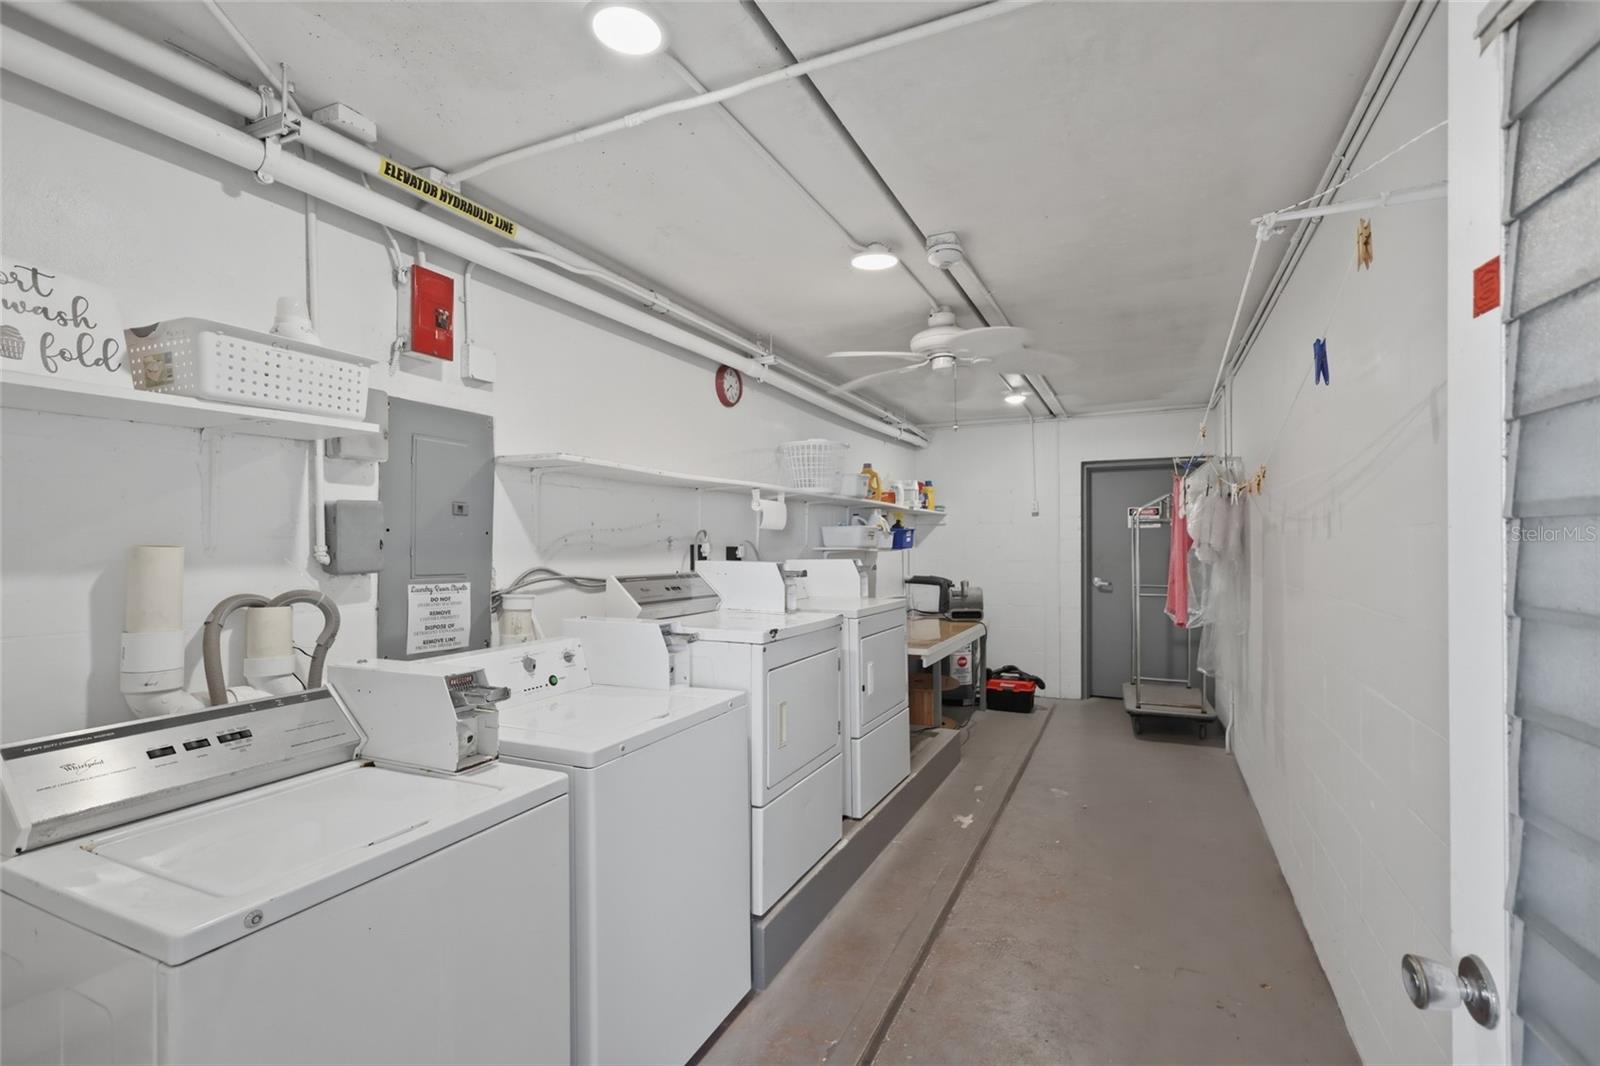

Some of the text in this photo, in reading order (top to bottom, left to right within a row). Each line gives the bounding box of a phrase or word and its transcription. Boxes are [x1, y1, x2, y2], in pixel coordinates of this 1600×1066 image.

[384, 161, 514, 235] ELEVATOR HYDRAULIC LINE
[1, 295, 97, 329] wash
[39, 332, 122, 374] fold
